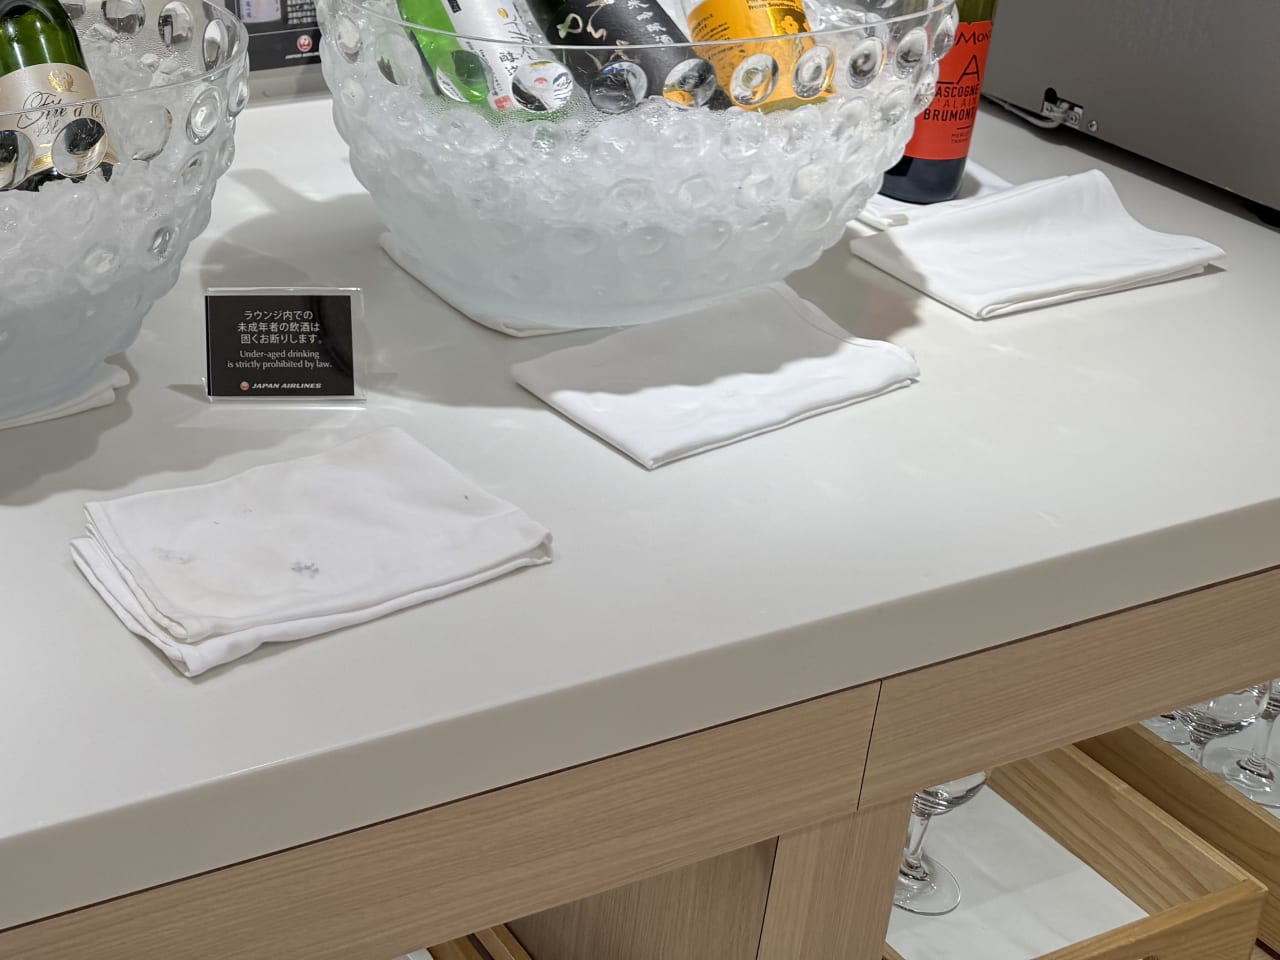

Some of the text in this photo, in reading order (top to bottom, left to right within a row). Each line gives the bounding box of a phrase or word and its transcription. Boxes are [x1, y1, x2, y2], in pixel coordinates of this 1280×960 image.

[935, 83, 980, 98] ASCOGNE
[923, 106, 976, 121] BRUMONT
[243, 310, 314, 321] ラウンジ内での
[237, 322, 321, 332] 未成年者の飲酒は
[240, 334, 323, 344] 固くお断りします。
[239, 350, 320, 359] Under-aged drinking
[227, 360, 333, 370] is strictly prohibited by law.
